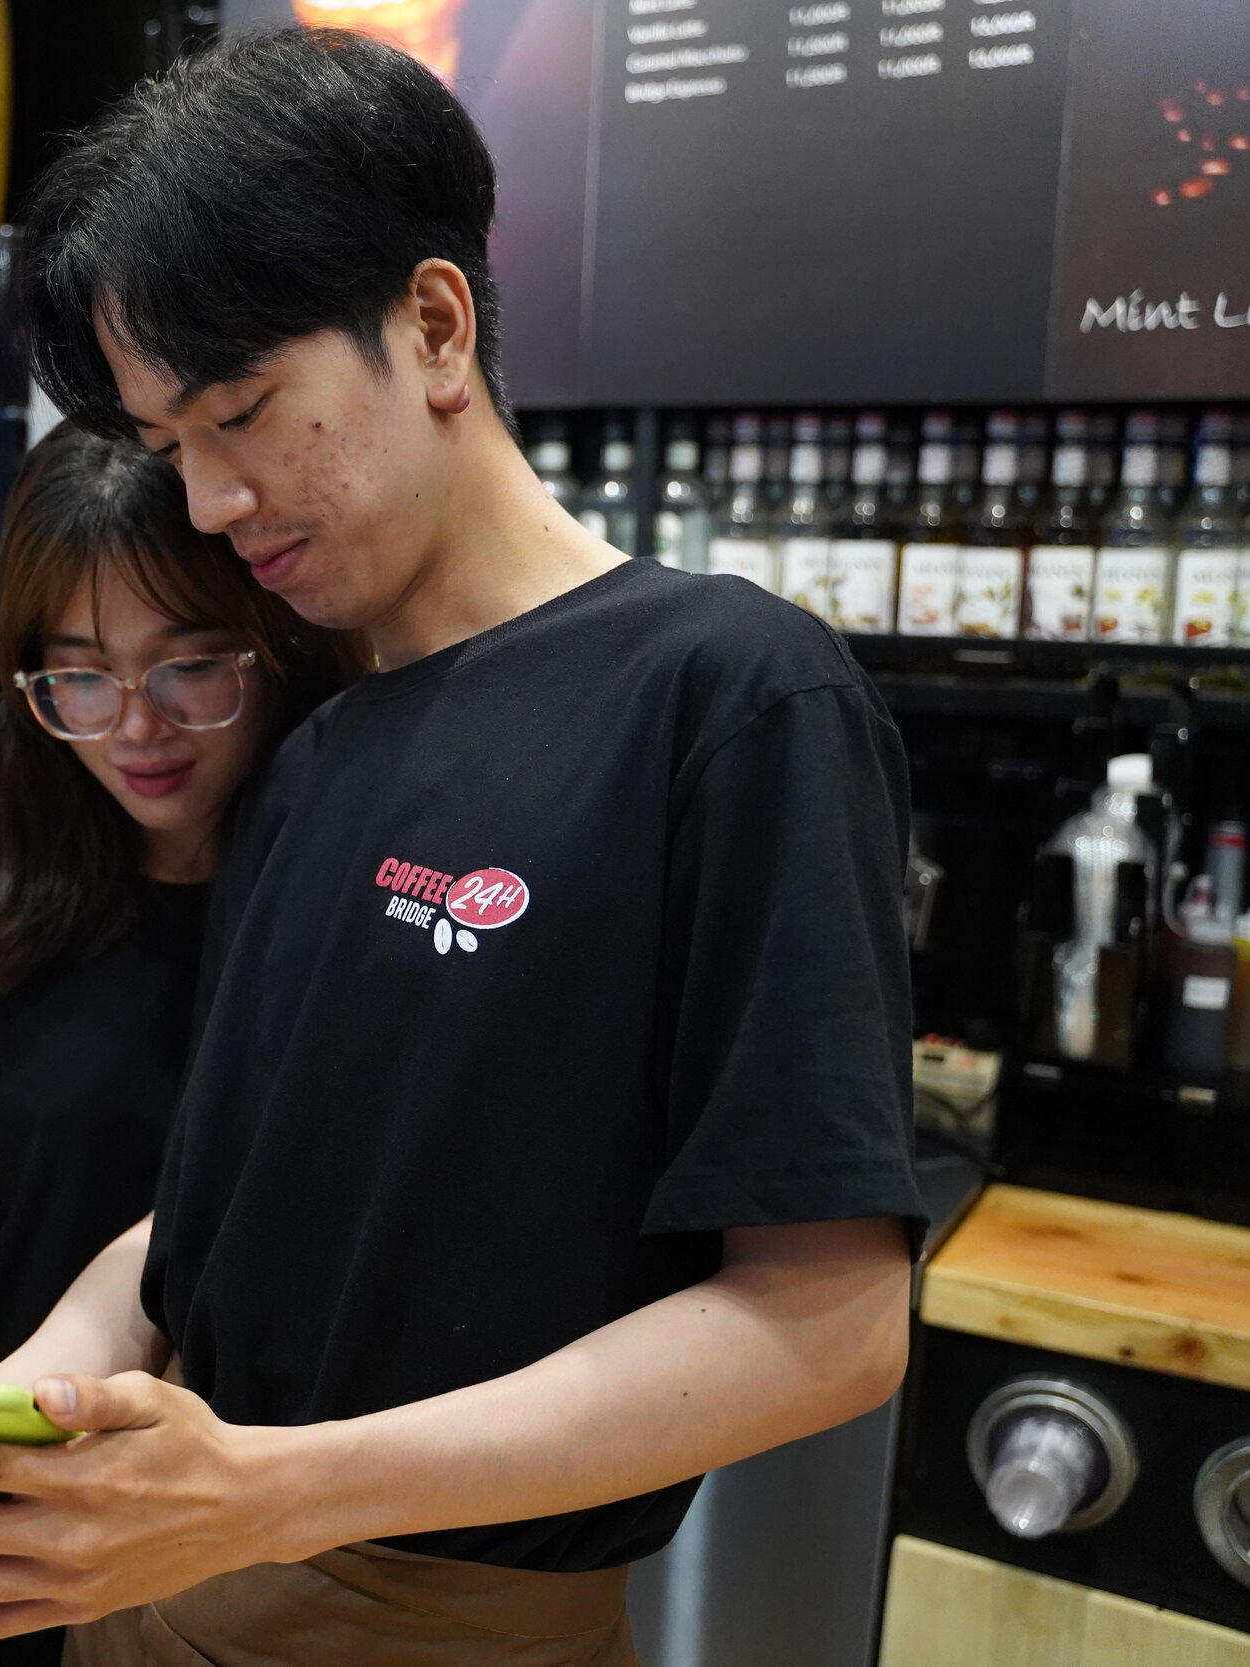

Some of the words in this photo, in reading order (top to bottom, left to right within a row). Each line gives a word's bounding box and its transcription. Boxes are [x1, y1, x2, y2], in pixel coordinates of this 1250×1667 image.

[375, 857, 454, 905] COFFEE
[451, 876, 523, 916] 24H
[385, 895, 437, 929] BRIDGE
